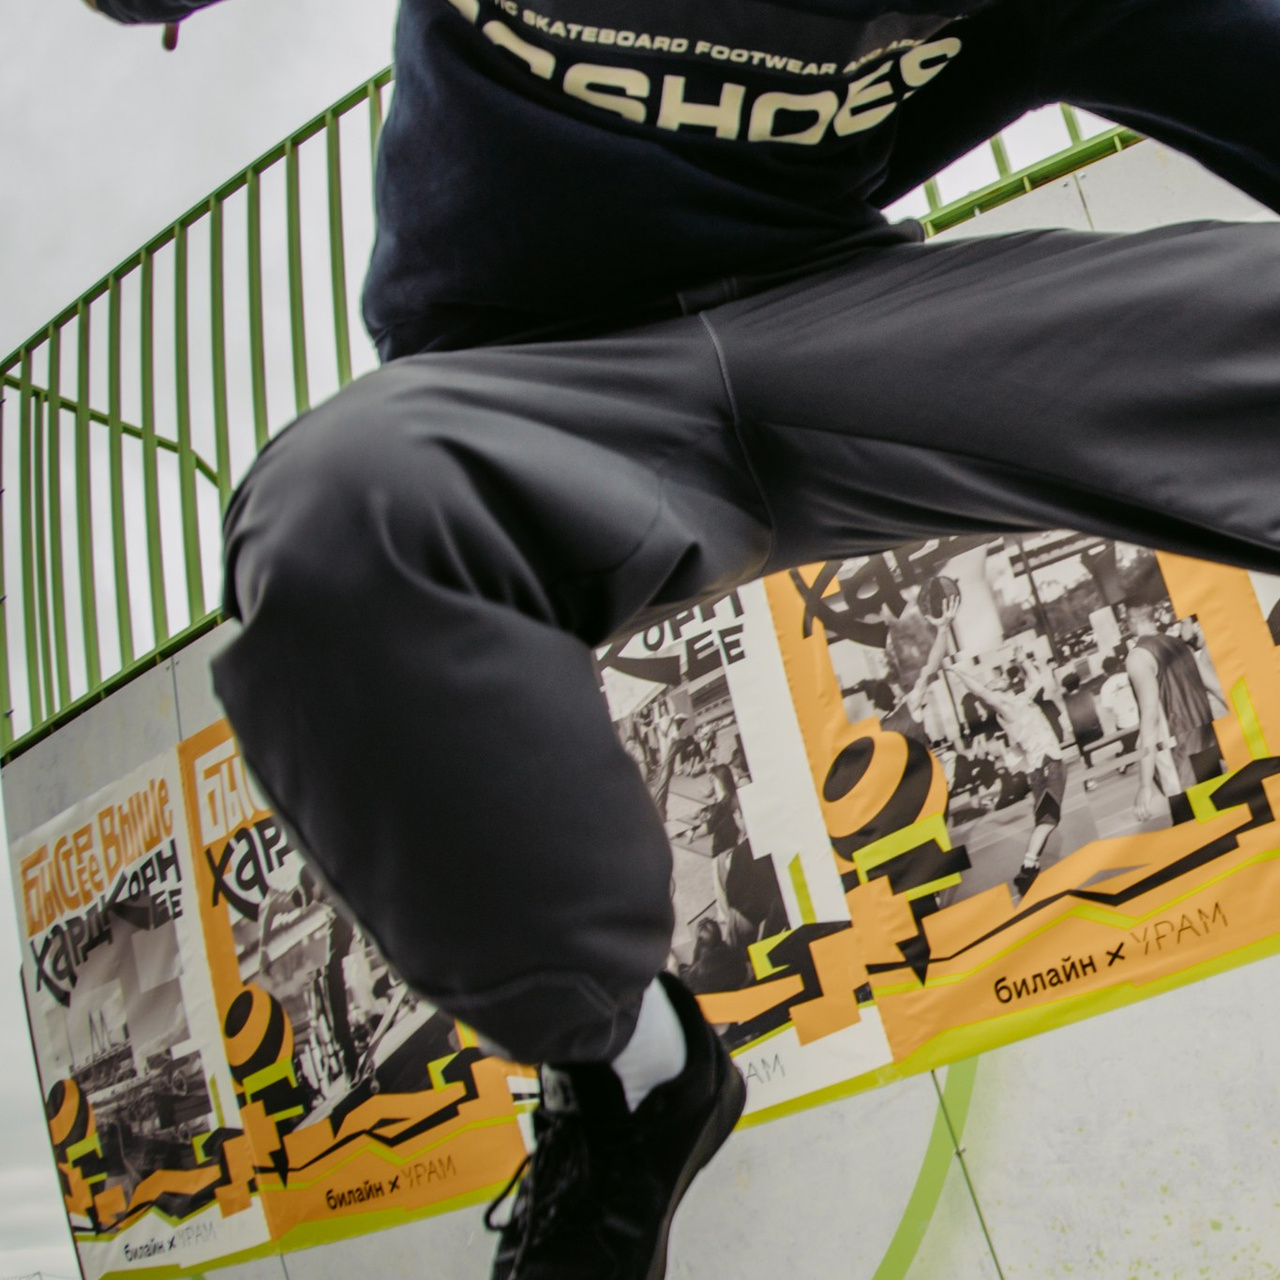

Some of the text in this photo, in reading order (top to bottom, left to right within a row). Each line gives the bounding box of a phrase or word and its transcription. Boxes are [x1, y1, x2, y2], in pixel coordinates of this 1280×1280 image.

[523, 10, 689, 53] SKATEBOARD
[695, 41, 836, 75] FOOTWEAR
[994, 954, 1097, 1003] билайн
[1130, 902, 1228, 955] УРАМ
[326, 1181, 384, 1210] билайн
[401, 1155, 457, 1188] УРАМ
[124, 1238, 166, 1262] билайн
